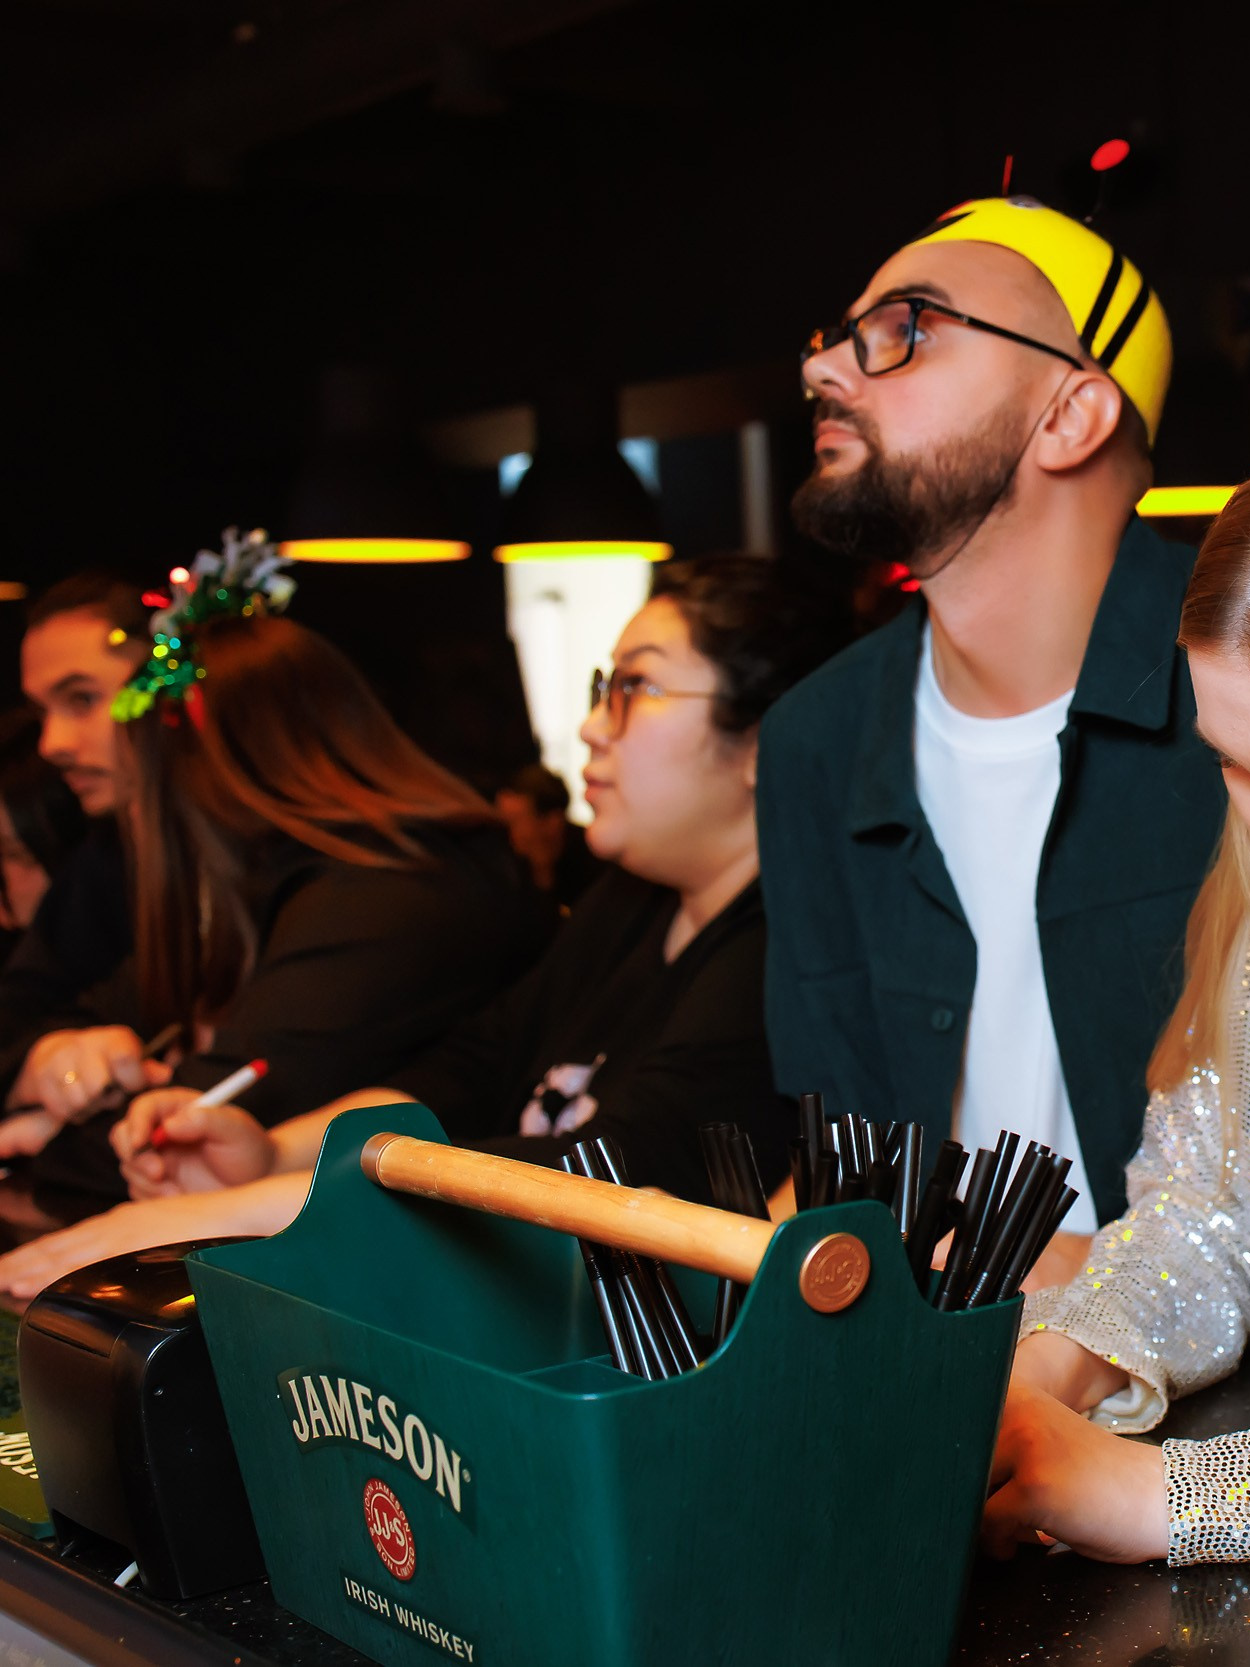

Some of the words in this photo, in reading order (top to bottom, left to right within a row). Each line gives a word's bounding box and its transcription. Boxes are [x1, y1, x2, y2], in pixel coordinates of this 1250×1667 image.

[287, 1374, 462, 1513] JAMESON
[364, 1483, 374, 1515] JOHN
[375, 1481, 410, 1532] JAMESON
[344, 1576, 391, 1618] IRISH
[394, 1603, 475, 1664] WHISKEY
